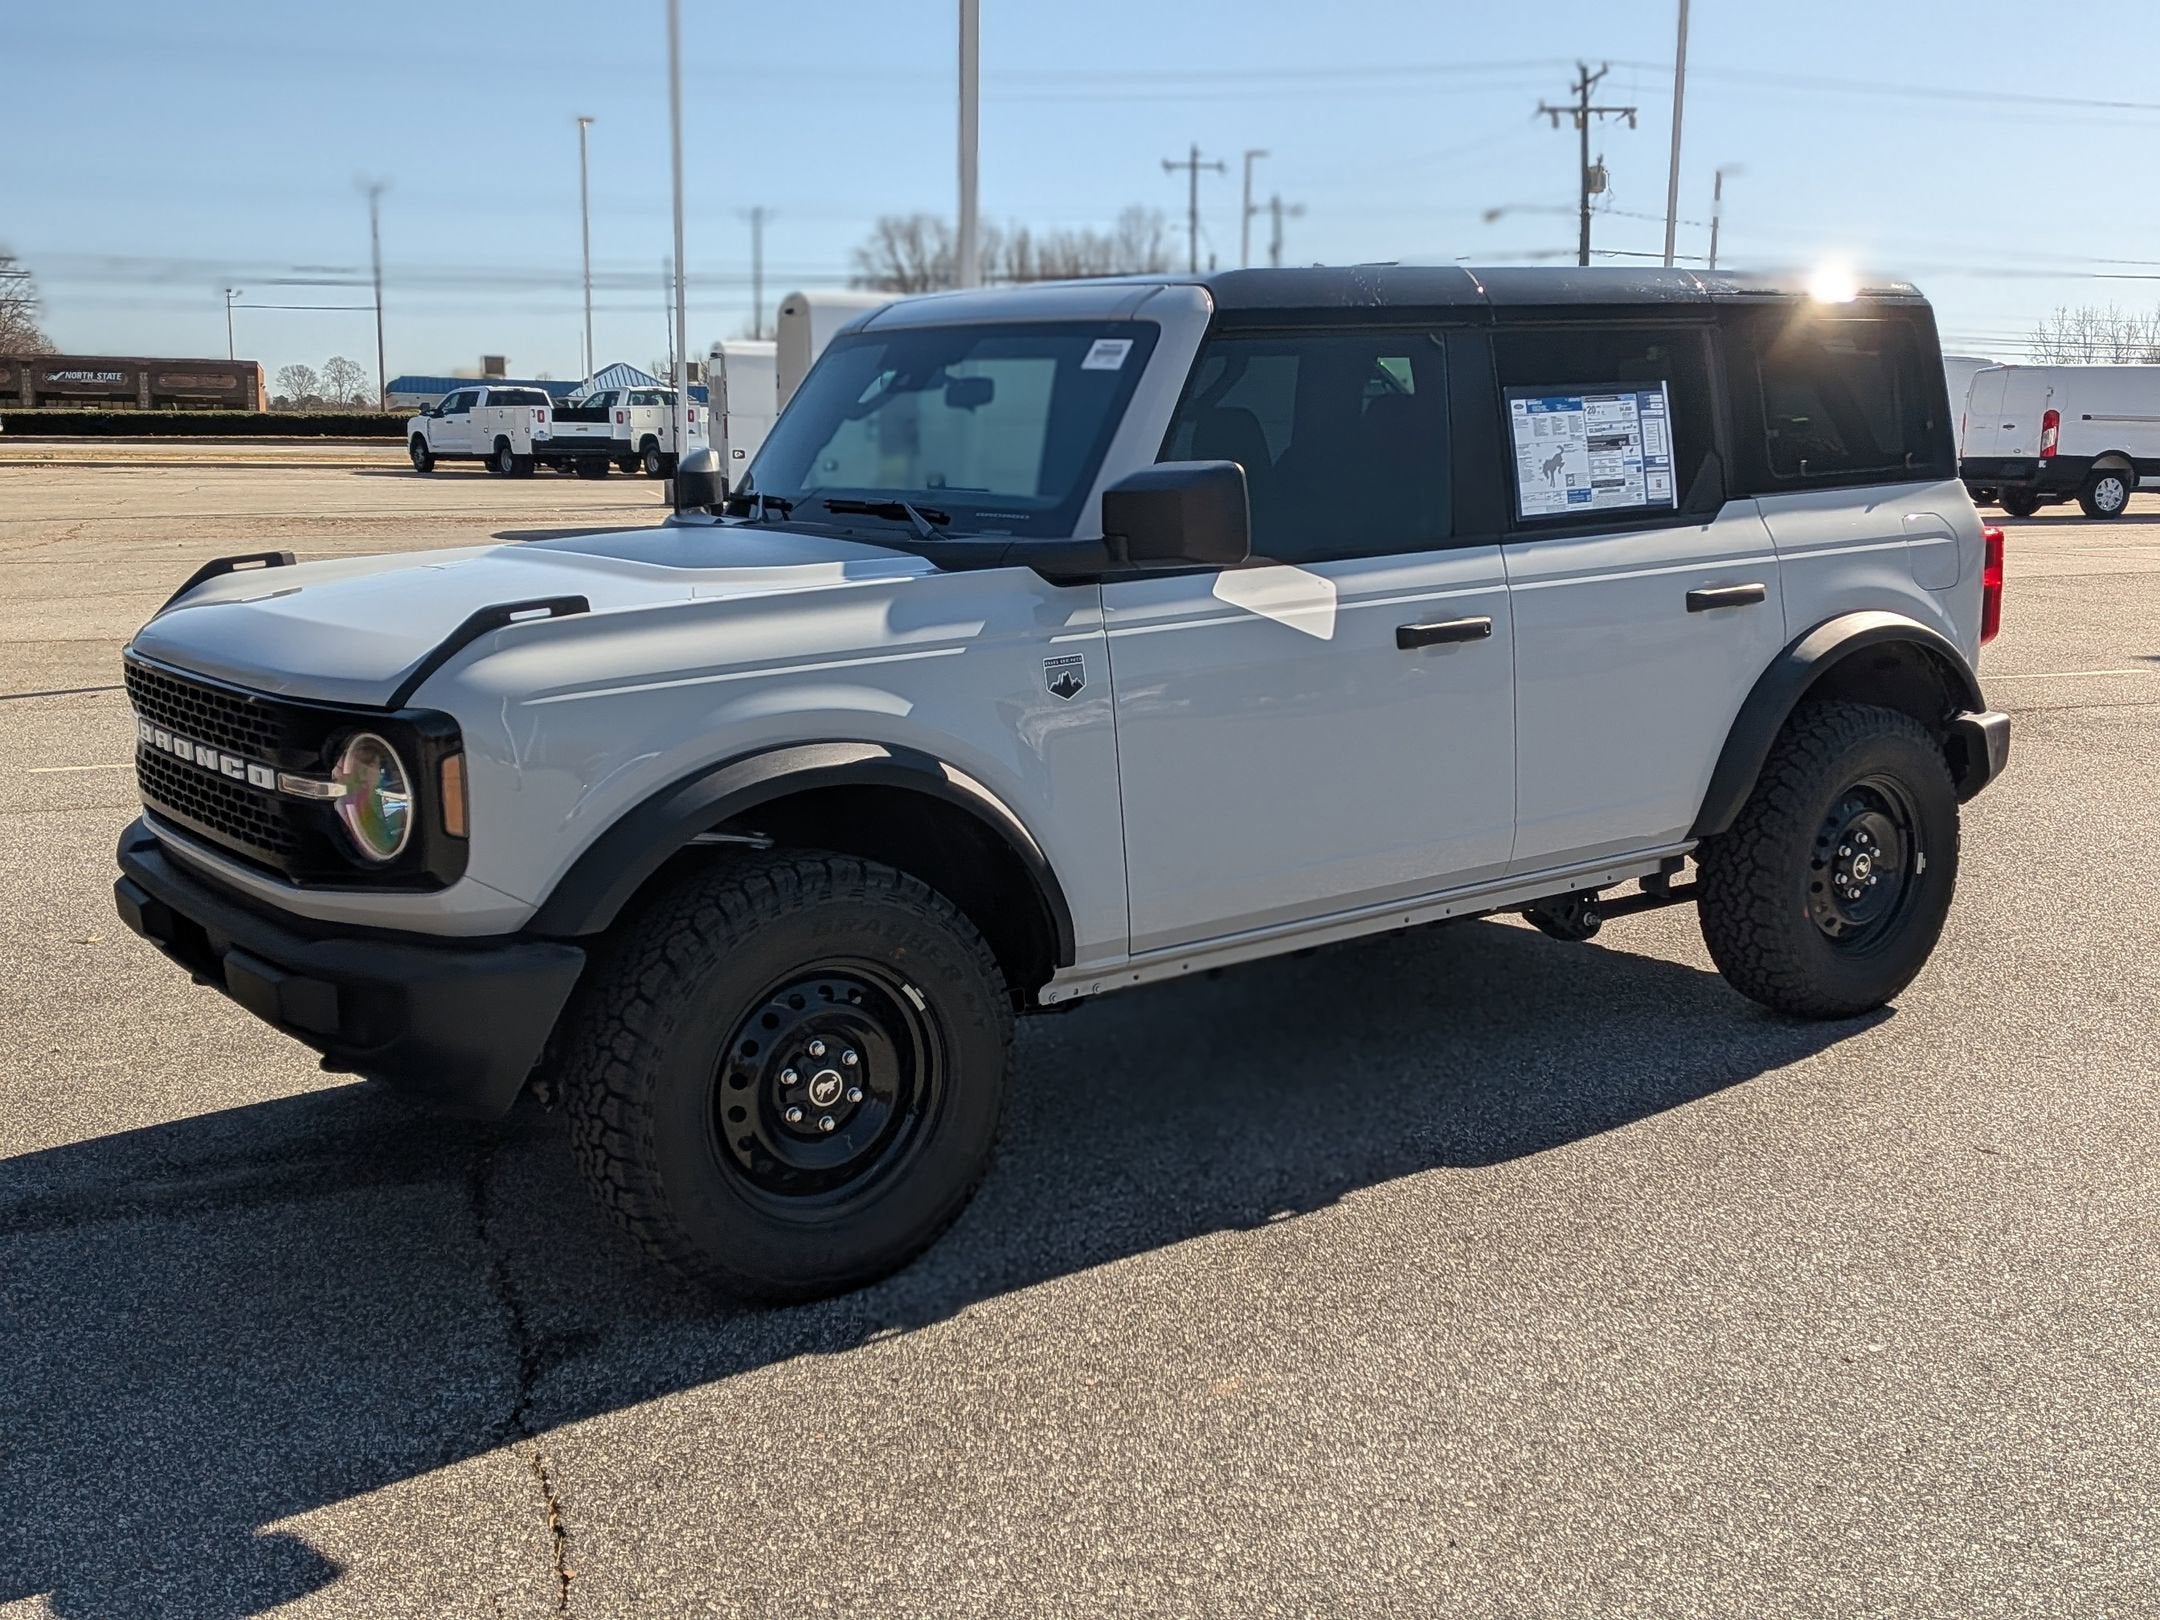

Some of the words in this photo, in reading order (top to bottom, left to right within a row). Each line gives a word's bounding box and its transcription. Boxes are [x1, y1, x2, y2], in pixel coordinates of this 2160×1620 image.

[65, 371, 93, 380] NORTH
[96, 372, 122, 380] STATE
[139, 720, 275, 790] BRONCO
